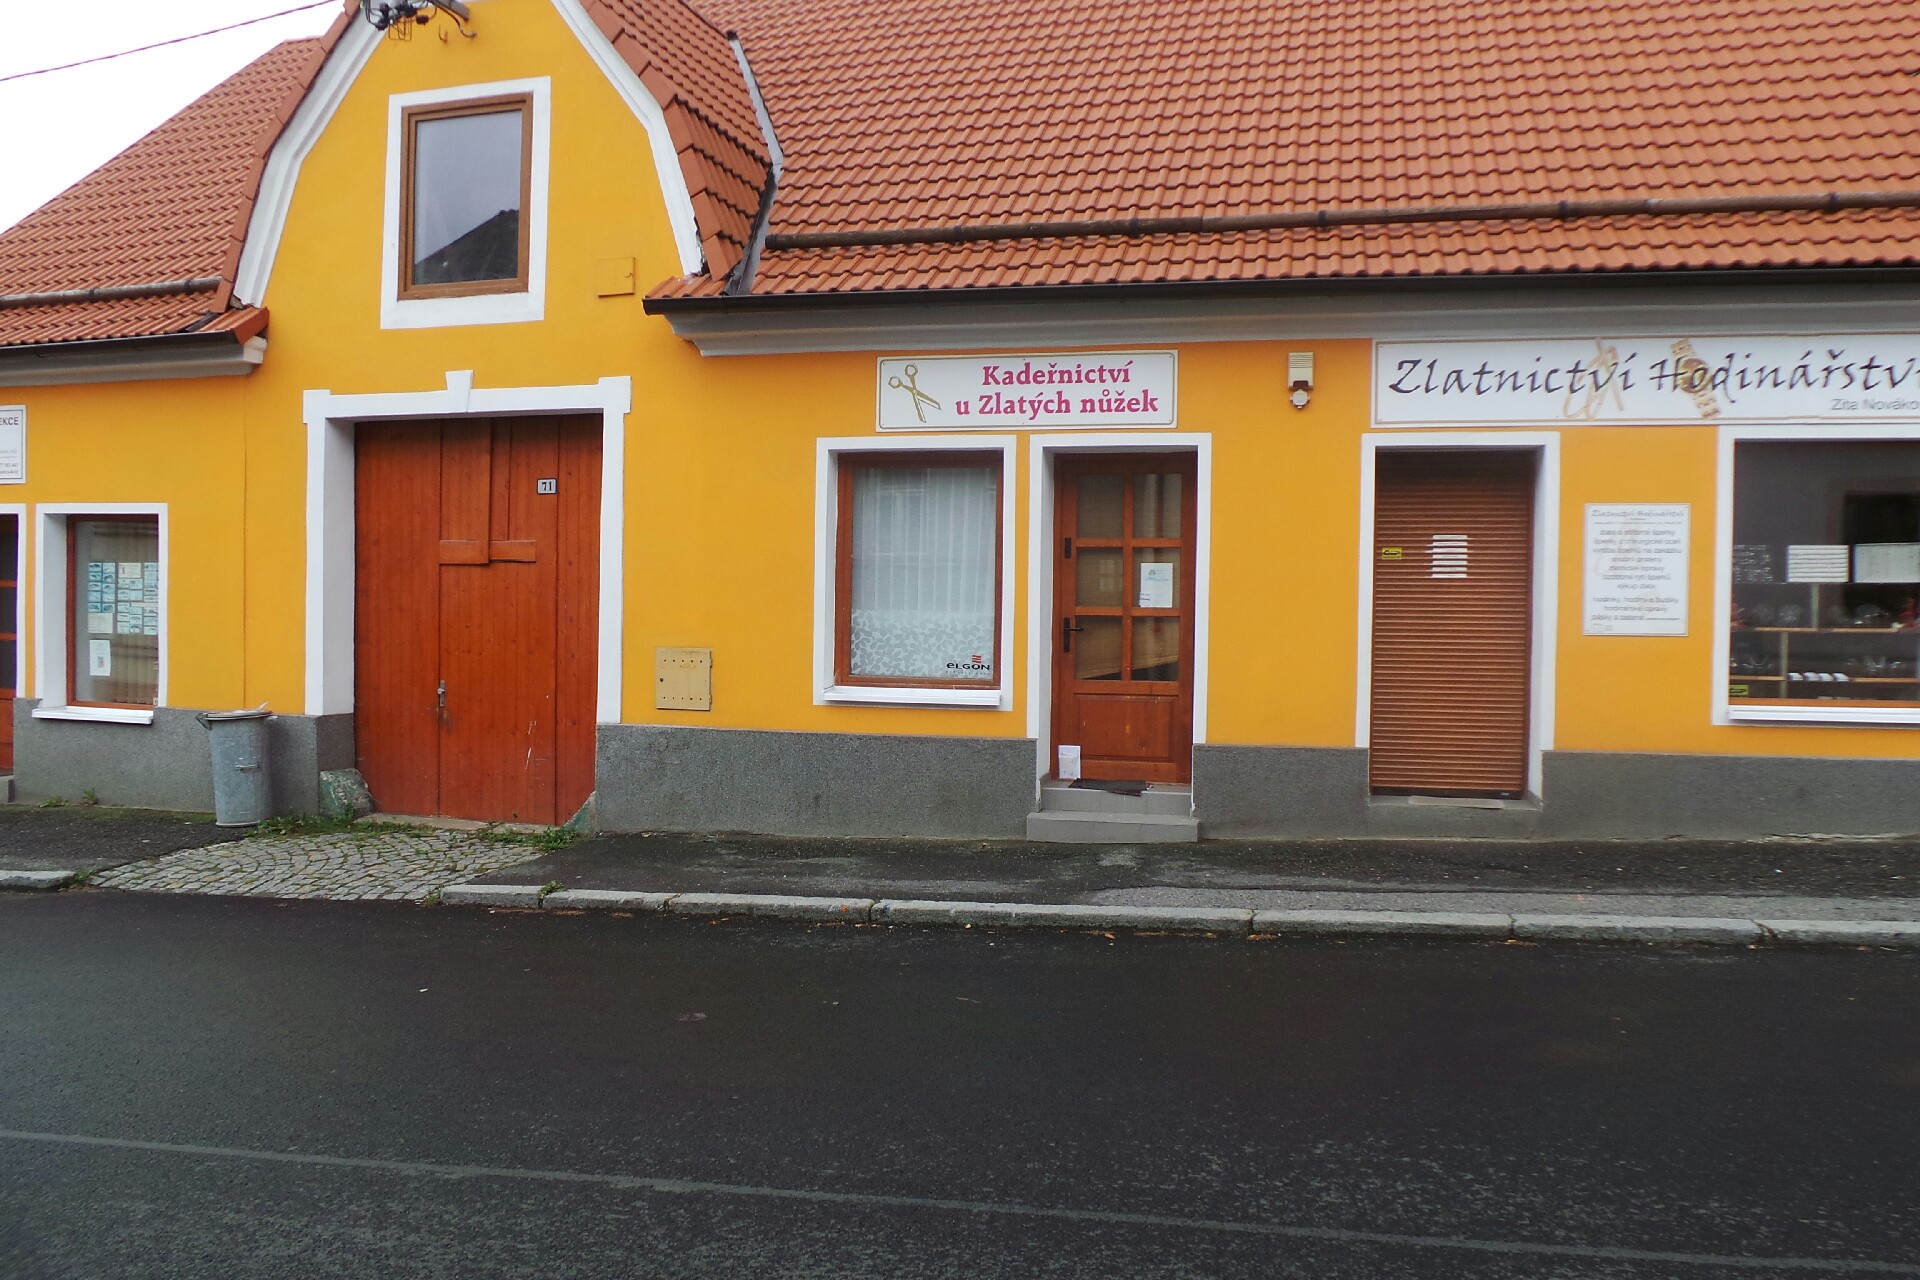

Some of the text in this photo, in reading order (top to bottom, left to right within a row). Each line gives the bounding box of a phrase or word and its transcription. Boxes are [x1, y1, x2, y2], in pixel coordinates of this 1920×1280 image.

[982, 360, 1134, 386] Kadeřnictví
[1388, 348, 1920, 404] Zlatnictví Hodinářstv
[955, 388, 1159, 420] u Zlatých nůžek
[541, 481, 552, 491] 71
